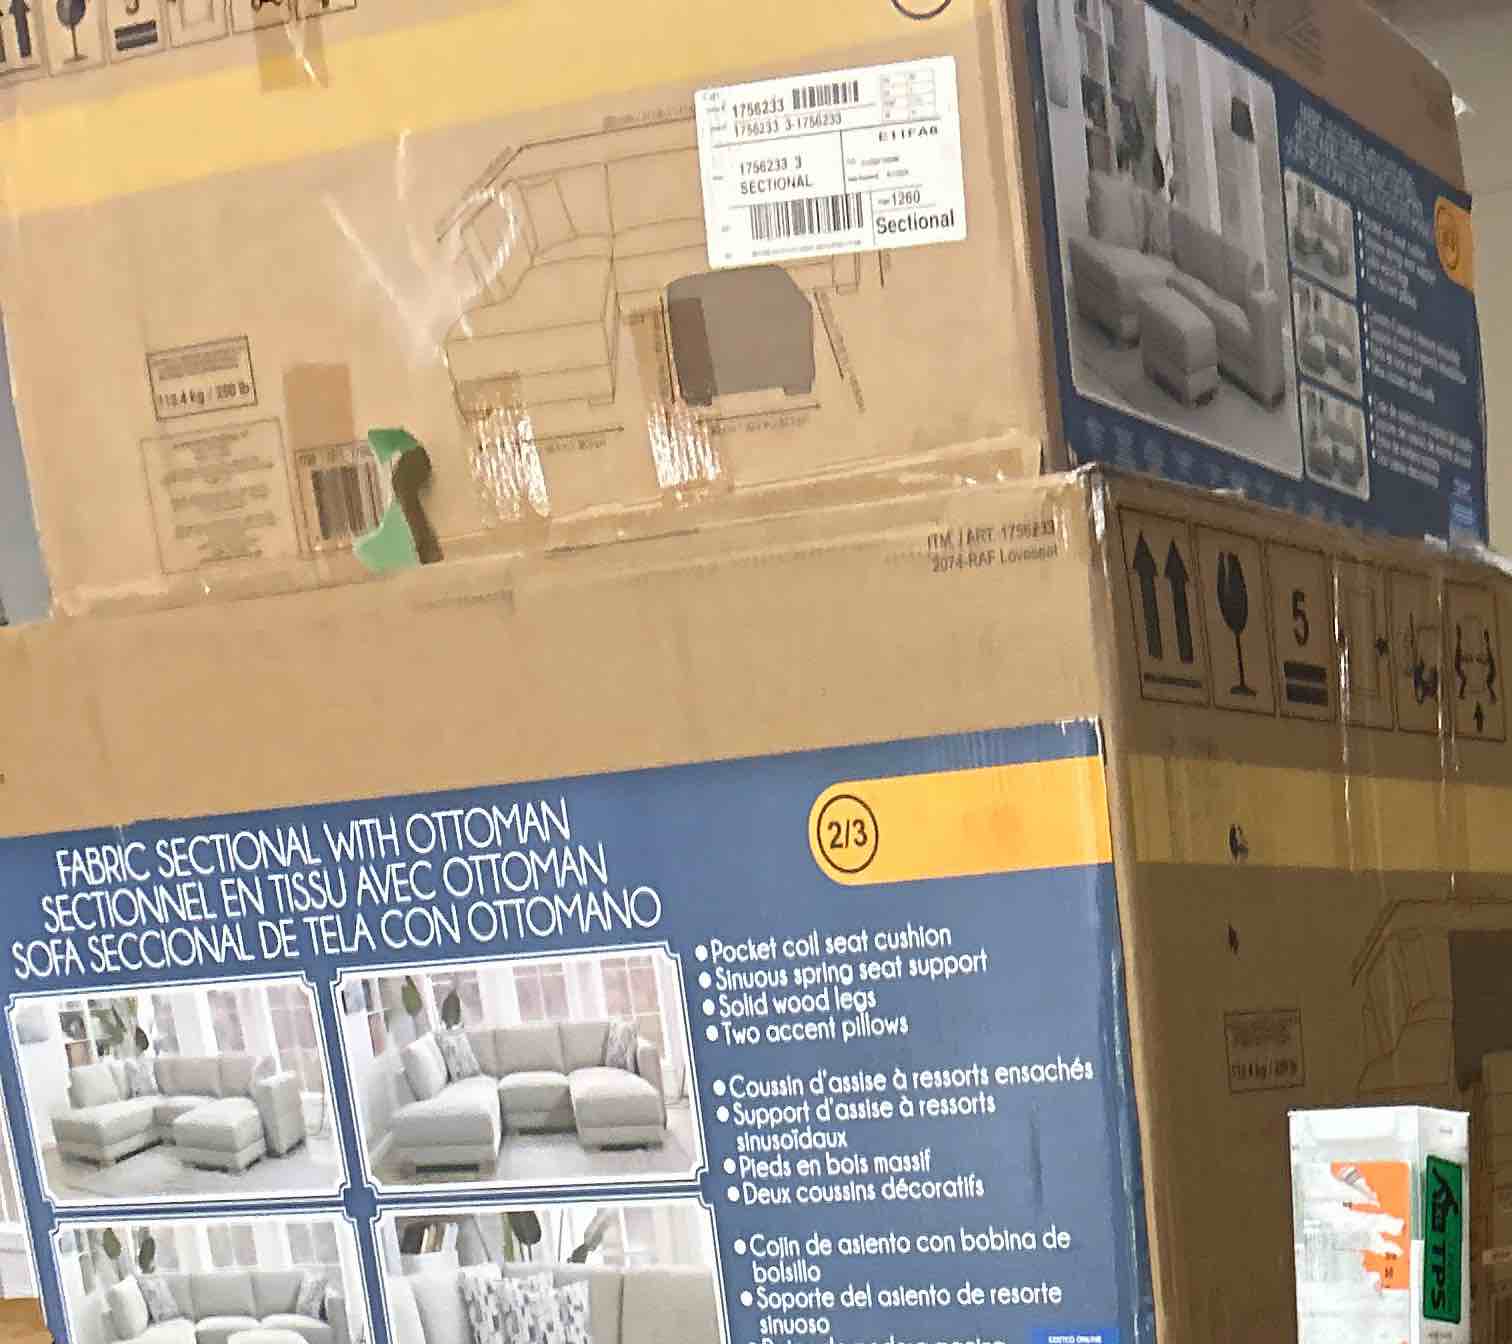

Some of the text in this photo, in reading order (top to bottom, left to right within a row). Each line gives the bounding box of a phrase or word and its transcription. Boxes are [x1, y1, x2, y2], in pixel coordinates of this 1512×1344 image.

[740, 174, 813, 195] SECTIONAL
[876, 208, 954, 234] Sectional
[56, 798, 570, 887] FABRIC SECTIONAL WITH OTTOMAN
[827, 819, 868, 849] 2/3
[42, 842, 608, 933] SECTIONNEL EN TISSU AVEC OTTOMAN
[12, 886, 663, 980] SOFA SECCIONAL DE TELA CON OTTOMANO
[710, 923, 952, 964] Pocket coil seat cushion
[715, 949, 989, 994] Sinuous spring seat support
[719, 987, 877, 1018] Solid wood legs
[722, 1011, 909, 1047] Two accent pillows
[729, 1058, 1095, 1099] Coussin d'assise à ressorts ensachés
[732, 1091, 997, 1131] Support d'assise à ressorts
[738, 1148, 931, 1179] Pieds en bois massif
[742, 1173, 985, 1207] Deux coussins décoratifs
[805, 1231, 833, 1256] de
[838, 1230, 911, 1256] asiento
[916, 1233, 956, 1255] con
[961, 1227, 1037, 1252] bobina
[1042, 1224, 1072, 1250] de
[753, 1261, 821, 1284] bolsillo
[756, 1282, 1062, 1312] Soporte del asiento de resorte
[759, 1315, 830, 1335] sinuoso
